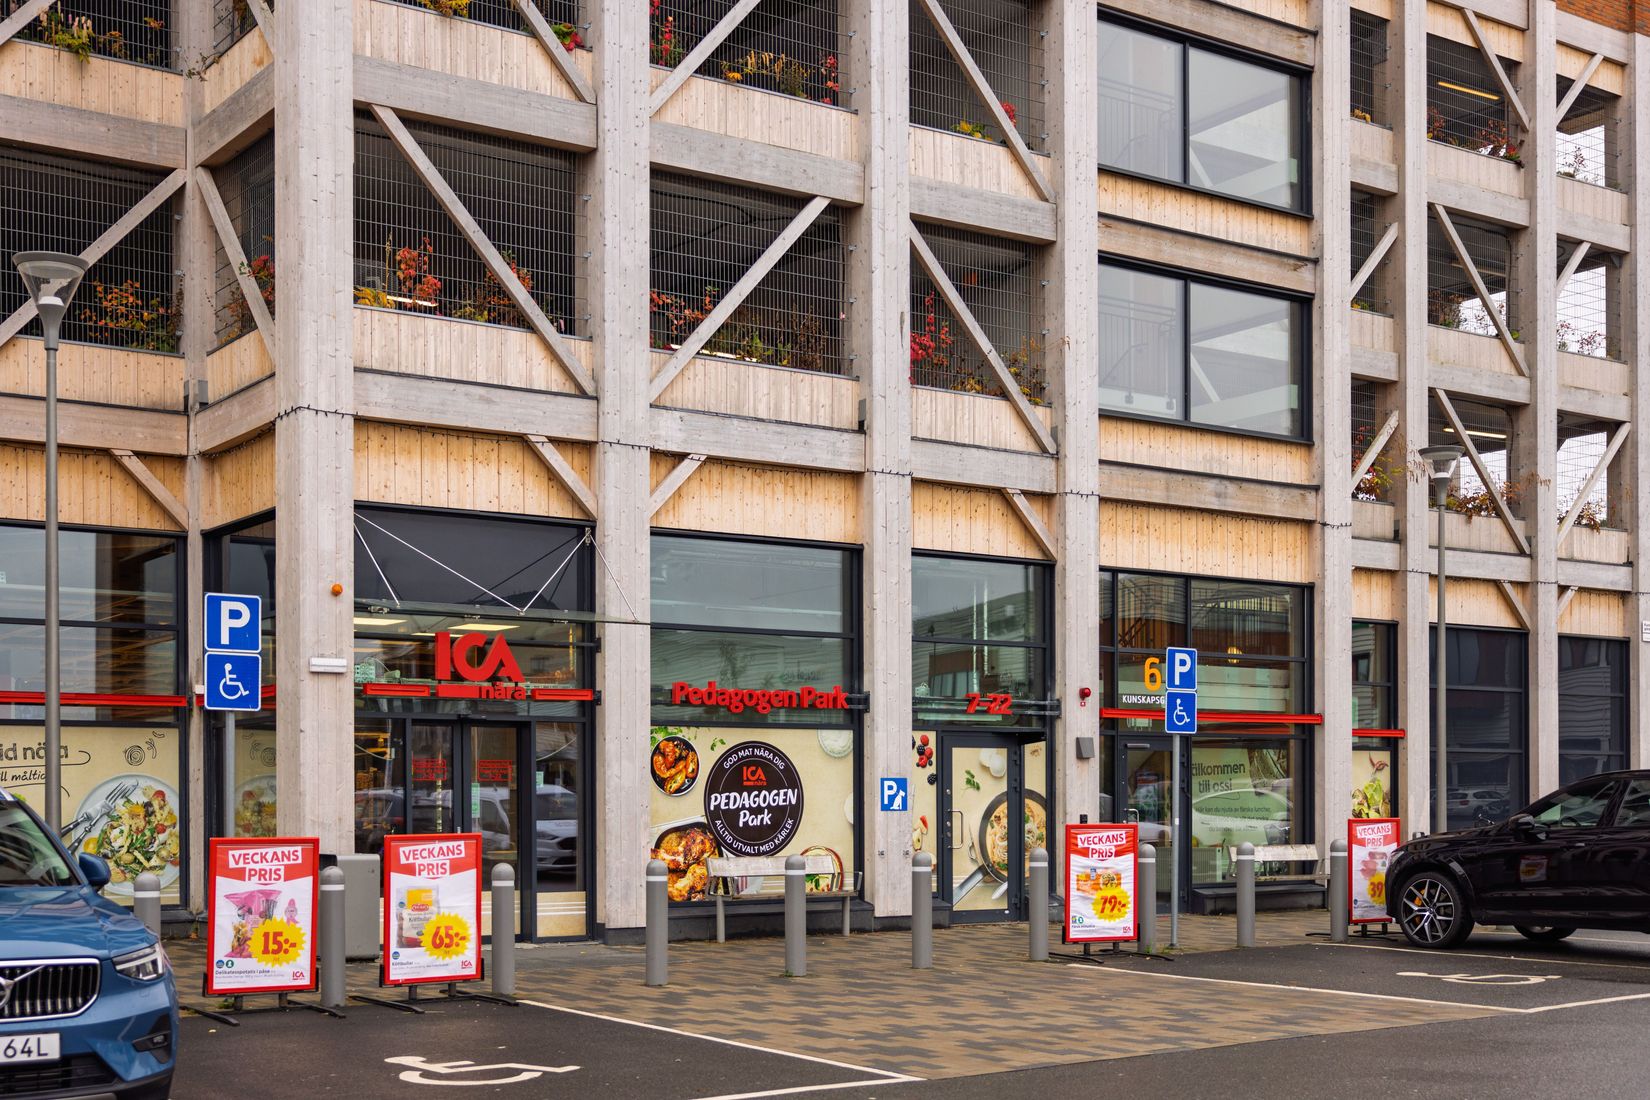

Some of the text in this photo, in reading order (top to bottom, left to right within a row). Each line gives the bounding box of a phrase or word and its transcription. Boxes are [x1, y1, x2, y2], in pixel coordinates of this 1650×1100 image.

[220, 600, 251, 645] P
[435, 631, 526, 683] ICA
[1144, 656, 1162, 691] 6
[1174, 652, 1192, 686] P
[481, 681, 527, 700] nära
[672, 680, 850, 714] Pedagogen Park
[1122, 694, 1165, 705] KUNSKAPSG
[965, 692, 1013, 715] 7-22
[22, 742, 69, 760] näa
[723, 747, 786, 770] GOD MAT NÄRA DIG
[743, 766, 767, 781] ICA
[883, 780, 898, 805] P
[1199, 779, 1211, 793] till
[710, 788, 798, 811] PEDAGOGEN
[738, 808, 772, 828] Park
[715, 817, 795, 854] ALLTID UTVALT MED KÄRLEK
[1079, 832, 1125, 847] VECKANS
[1358, 824, 1391, 837] VECKANS
[1366, 836, 1383, 847] PRIS
[231, 849, 300, 866] VECKANS
[402, 843, 464, 862] VECKANS
[1090, 847, 1114, 858] PRIS
[247, 867, 282, 882] PRIS
[417, 862, 448, 876] PRIS
[3, 1036, 49, 1059] 64L
